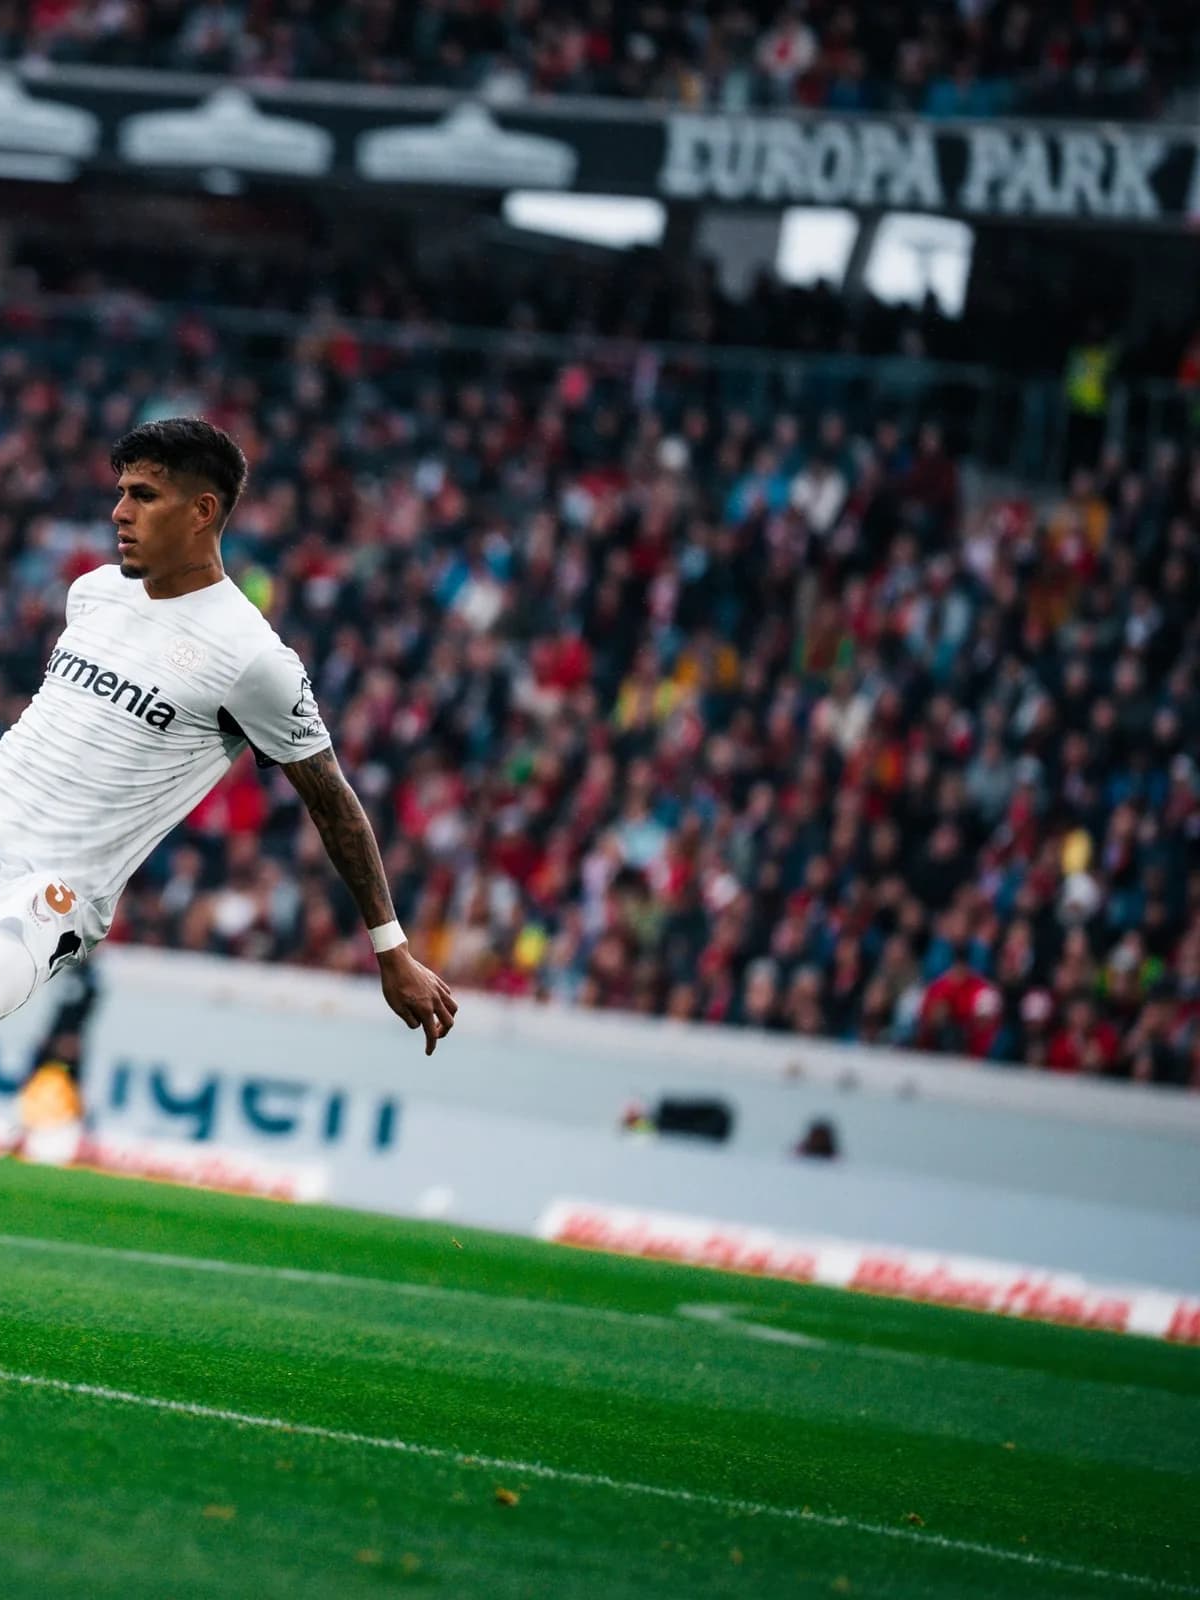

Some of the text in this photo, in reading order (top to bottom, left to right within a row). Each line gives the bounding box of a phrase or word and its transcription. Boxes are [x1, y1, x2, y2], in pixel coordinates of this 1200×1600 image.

[660, 114, 943, 206] EUROPA
[963, 127, 1165, 219] PARK
[45, 883, 77, 915] 3
